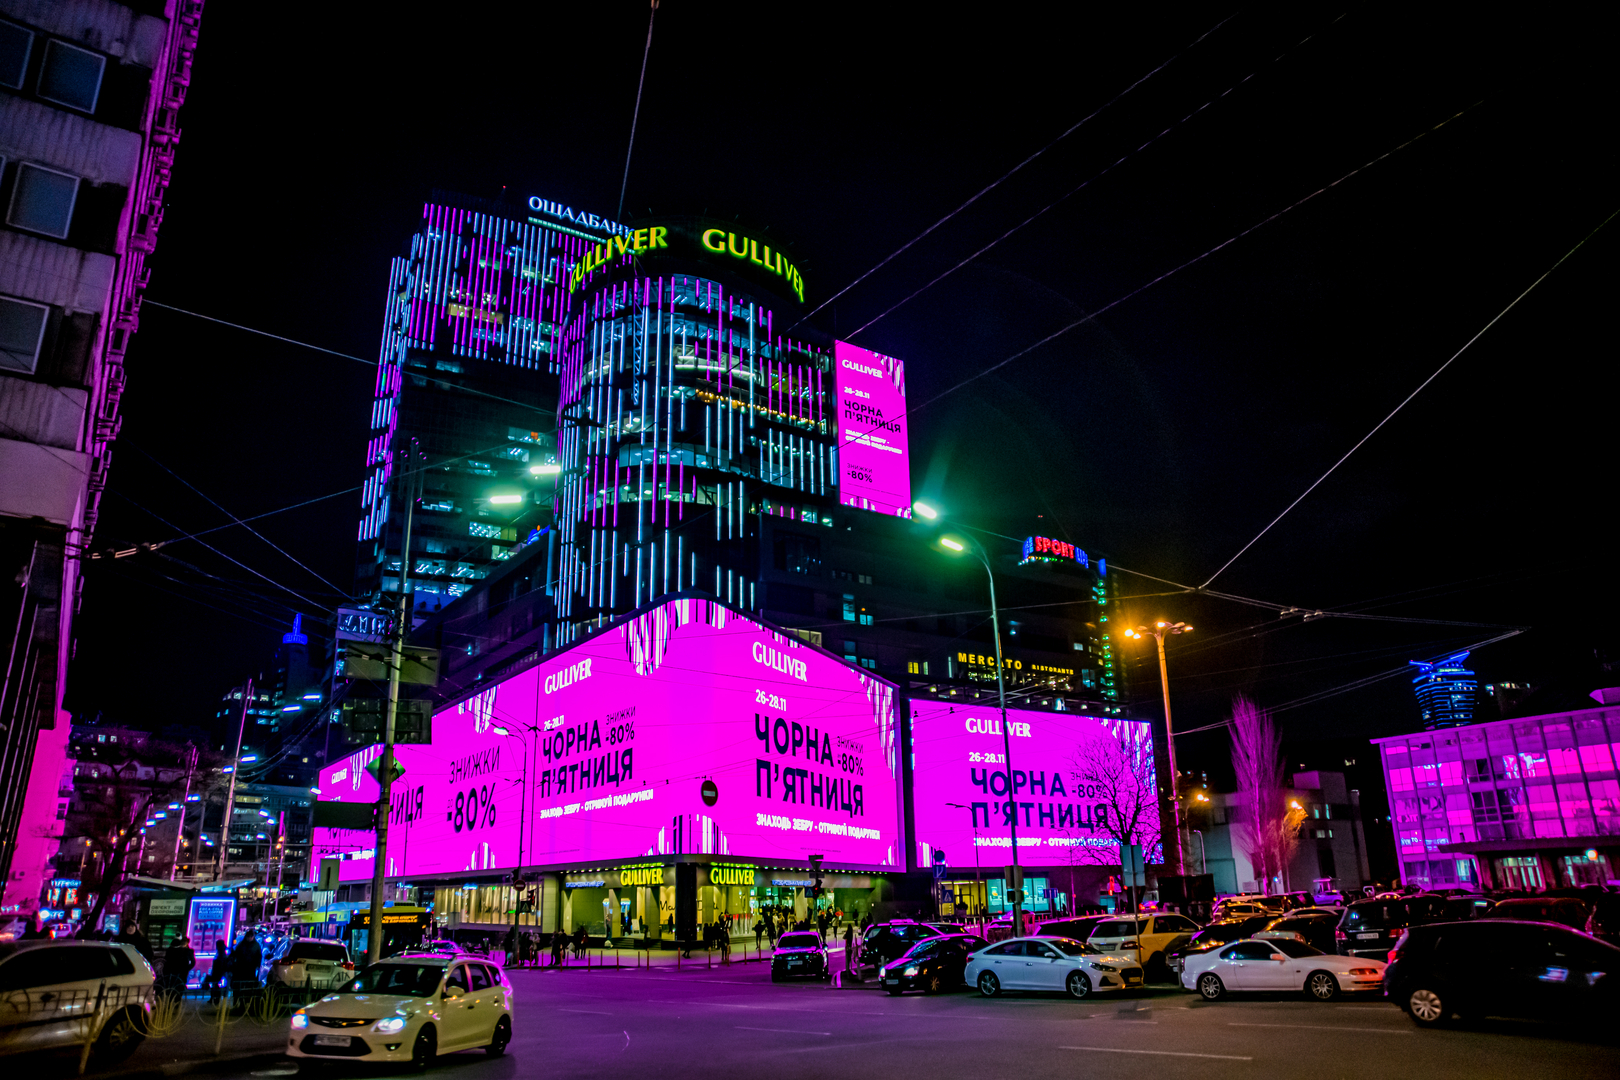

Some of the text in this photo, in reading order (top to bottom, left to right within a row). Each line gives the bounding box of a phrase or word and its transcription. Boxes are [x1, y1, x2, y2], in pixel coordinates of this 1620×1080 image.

[528, 195, 635, 241] ОЩАДБАНК
[569, 226, 668, 294] GULLIVER
[702, 228, 804, 302] GULLIVER
[841, 359, 883, 379] GULLIVER
[844, 400, 884, 418] ЧОРНА
[844, 410, 901, 433] П'ЯТНИЦЯ
[847, 470, 873, 483] -80%
[1035, 535, 1075, 559] SPORT
[752, 641, 807, 682] GULLIVER
[957, 652, 1074, 675] MERCTO RISTORANTE
[544, 657, 592, 695] GULLIVER
[755, 689, 787, 712] 26-28.11
[605, 705, 636, 726] ЗНИЖКИ
[965, 717, 1032, 738] GULLVER
[542, 719, 602, 764] ЧОРНА
[605, 721, 636, 746] -80%
[754, 712, 835, 768] ЧОРНА
[836, 735, 864, 754] ЗНИЖКИ
[449, 745, 500, 784] ЗНИЖКИ
[836, 752, 864, 777] -80%
[968, 751, 1006, 764] 26-28.11
[541, 747, 633, 799] П'ЯТНИЦЯ
[970, 767, 1067, 798] ЧОРНА
[755, 758, 864, 818] П'ЯТНИЦЯ
[1071, 783, 1108, 799] -80%
[446, 782, 496, 834] -80%
[970, 801, 1109, 833] П'ЯТНИЦЯ
[756, 812, 792, 830] ЗНАХОДЬ
[792, 818, 814, 832] ЗЕБРУ
[620, 867, 664, 886] GULLIVER
[710, 867, 755, 886] GULLIVER
